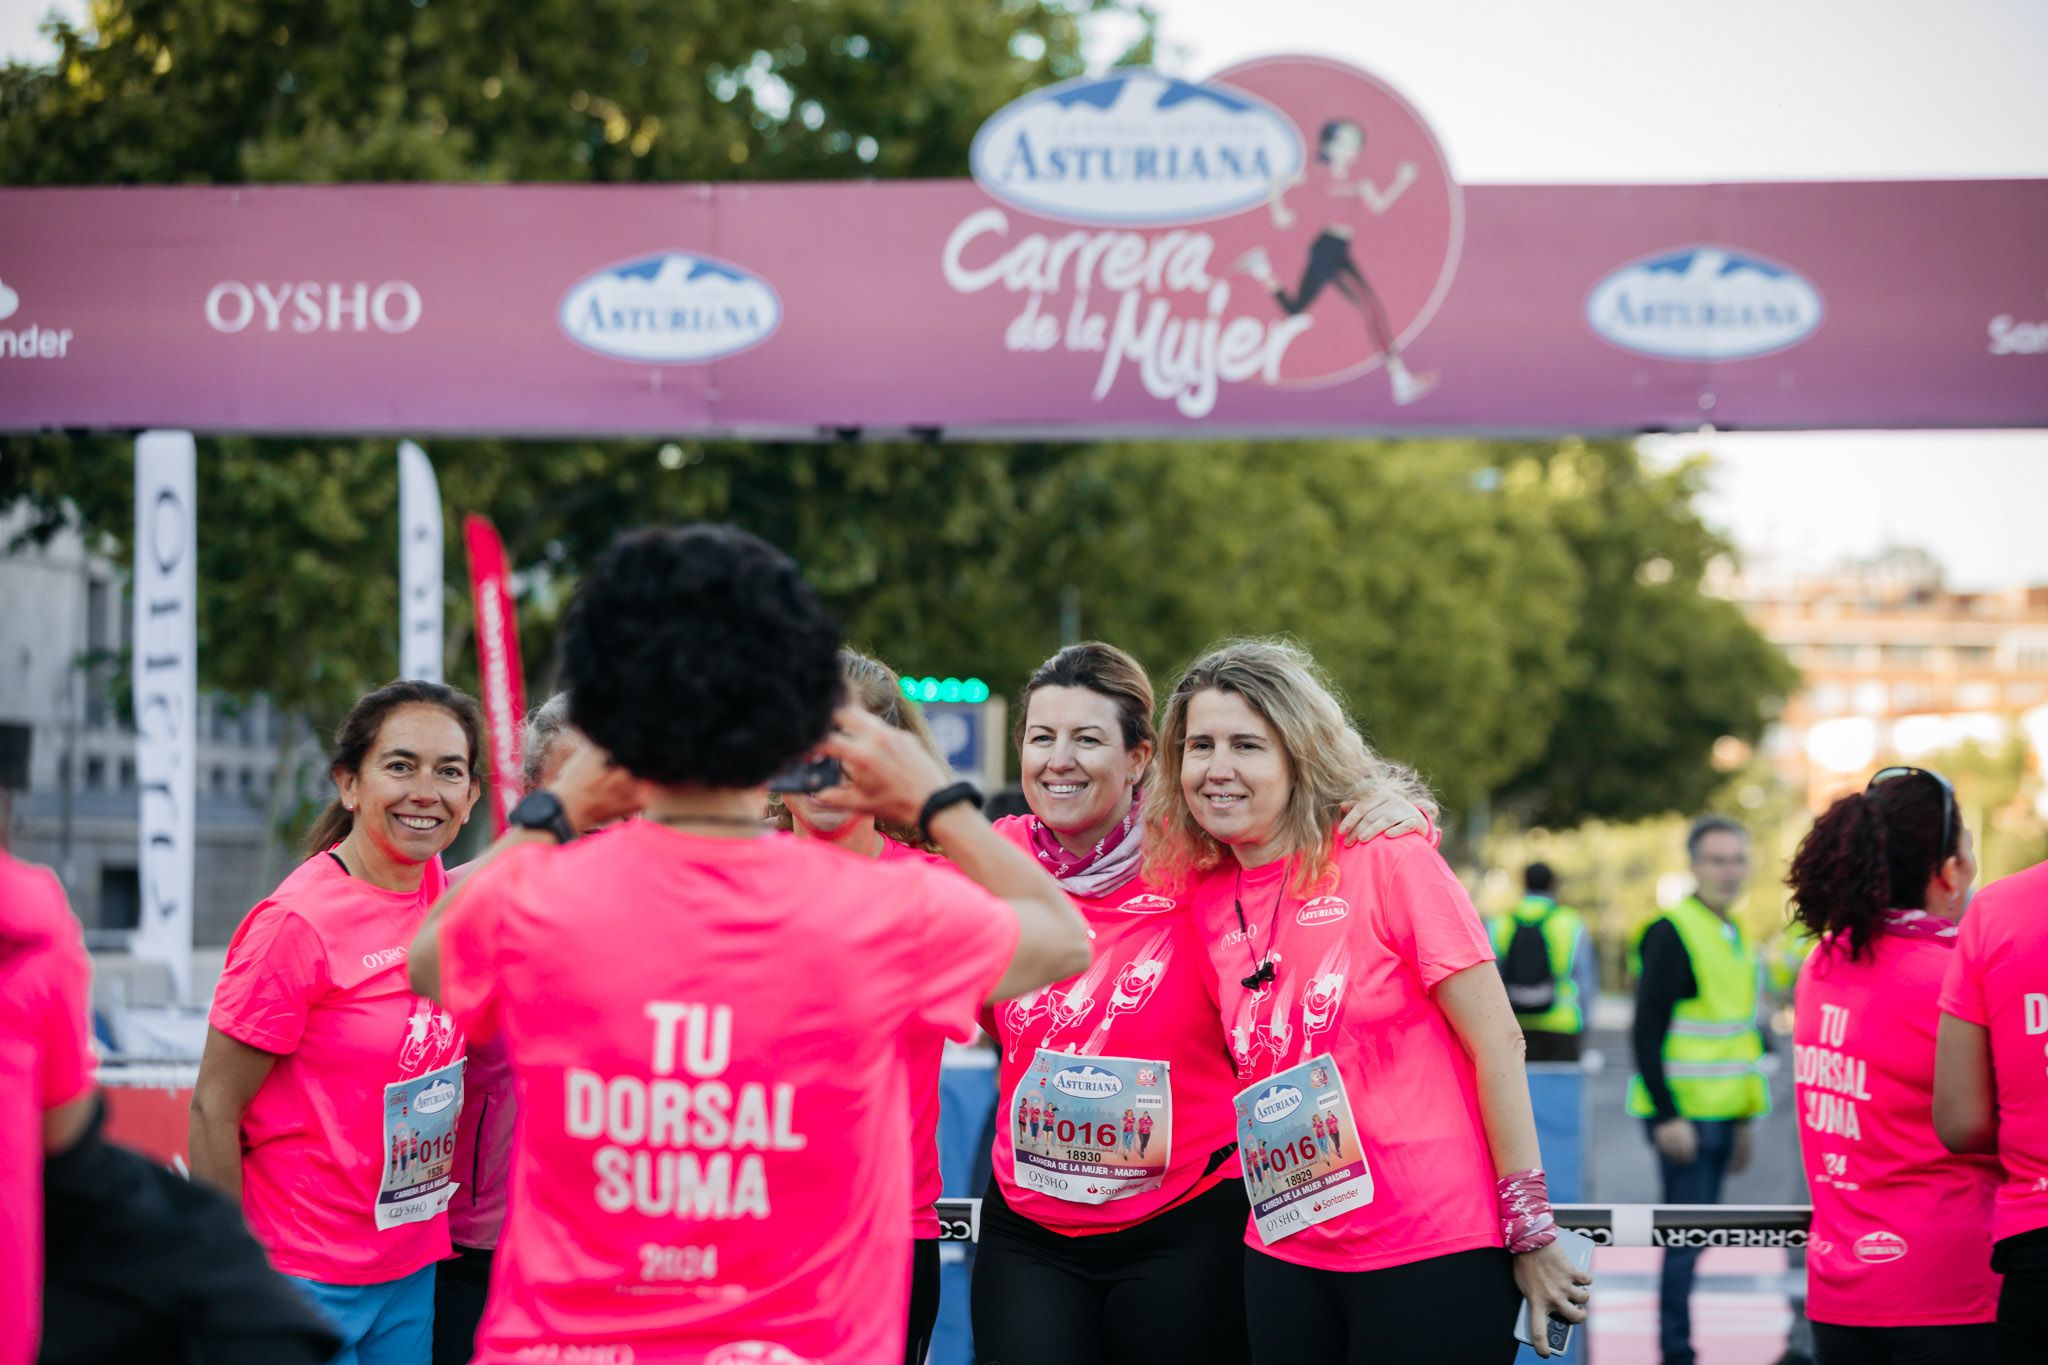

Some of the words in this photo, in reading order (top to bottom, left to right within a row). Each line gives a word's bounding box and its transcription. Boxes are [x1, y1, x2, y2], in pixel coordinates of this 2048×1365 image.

[1002, 128, 1272, 182] ASTURIANA
[942, 208, 1215, 294] Carrera
[205, 280, 422, 333] OYSHO
[580, 292, 762, 332] ASTURIANA
[1005, 292, 1061, 352] de
[1090, 280, 1314, 420] Mujer
[1299, 907, 1345, 921] ASTURIANA
[645, 1003, 731, 1076] TU
[1820, 1003, 1849, 1047] TU
[1057, 1074, 1118, 1092] ASTURIANA
[417, 1090, 453, 1109] ASTURIANA
[564, 1068, 806, 1152] DORSAL
[1256, 1095, 1301, 1120] ASTURIANA
[419, 1132, 453, 1163] 016
[1057, 1119, 1117, 1147] 016
[1028, 1154, 1057, 1170] CARRERA
[1058, 1162, 1068, 1172] DE
[1069, 1164, 1080, 1173] LA
[1081, 1166, 1109, 1176] MUJER
[1114, 1168, 1147, 1177] MADRID
[1066, 1150, 1101, 1163] 18930
[1270, 1136, 1317, 1173] 016
[592, 1147, 771, 1220] SUMA
[1029, 1170, 1068, 1190] OYSHO
[1262, 1195, 1285, 1212] CARRERA
[1283, 1191, 1293, 1202] DE
[1292, 1189, 1302, 1198] LA
[1301, 1181, 1322, 1195] MUJER
[1324, 1168, 1351, 1186] MADRID
[1285, 1169, 1313, 1188] 18929
[389, 1200, 427, 1218] OYSHO
[1321, 1188, 1360, 1210] Santander
[1266, 1208, 1300, 1233] OYSHO
[638, 1242, 718, 1281] 2024
